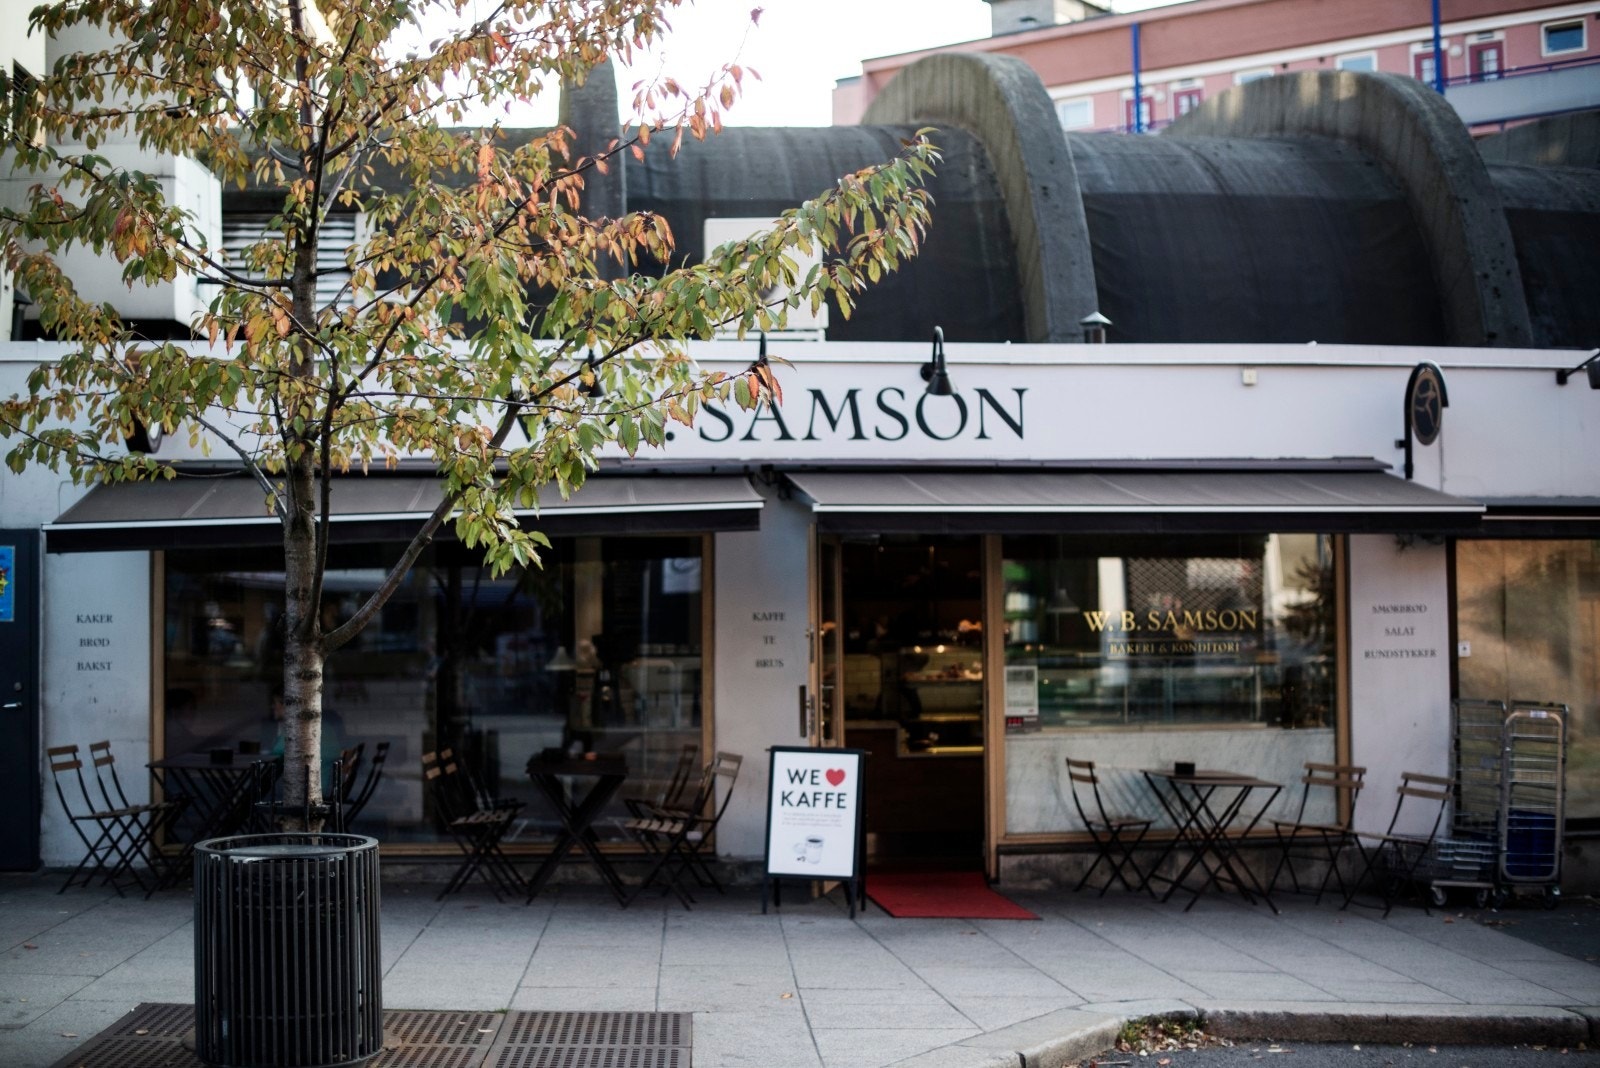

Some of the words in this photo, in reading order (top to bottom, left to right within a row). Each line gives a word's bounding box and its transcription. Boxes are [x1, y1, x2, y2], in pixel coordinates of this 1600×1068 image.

[699, 386, 1029, 442] SAMSON
[76, 613, 113, 624] KAKER
[752, 611, 786, 622] KAFFE
[1083, 610, 1113, 632] W.
[1121, 610, 1141, 632] B.
[1148, 609, 1257, 632] SAMSON
[1384, 626, 1416, 636] SALAT
[79, 637, 110, 648] BRØD
[1109, 642, 1155, 655] BAKERI
[1159, 643, 1168, 654] &
[1172, 641, 1240, 654] KONDITORI
[1364, 648, 1437, 659] RUNDSTYKKER
[77, 661, 112, 671] BAKST
[787, 768, 821, 786] WE
[781, 791, 848, 809] KAFFE
